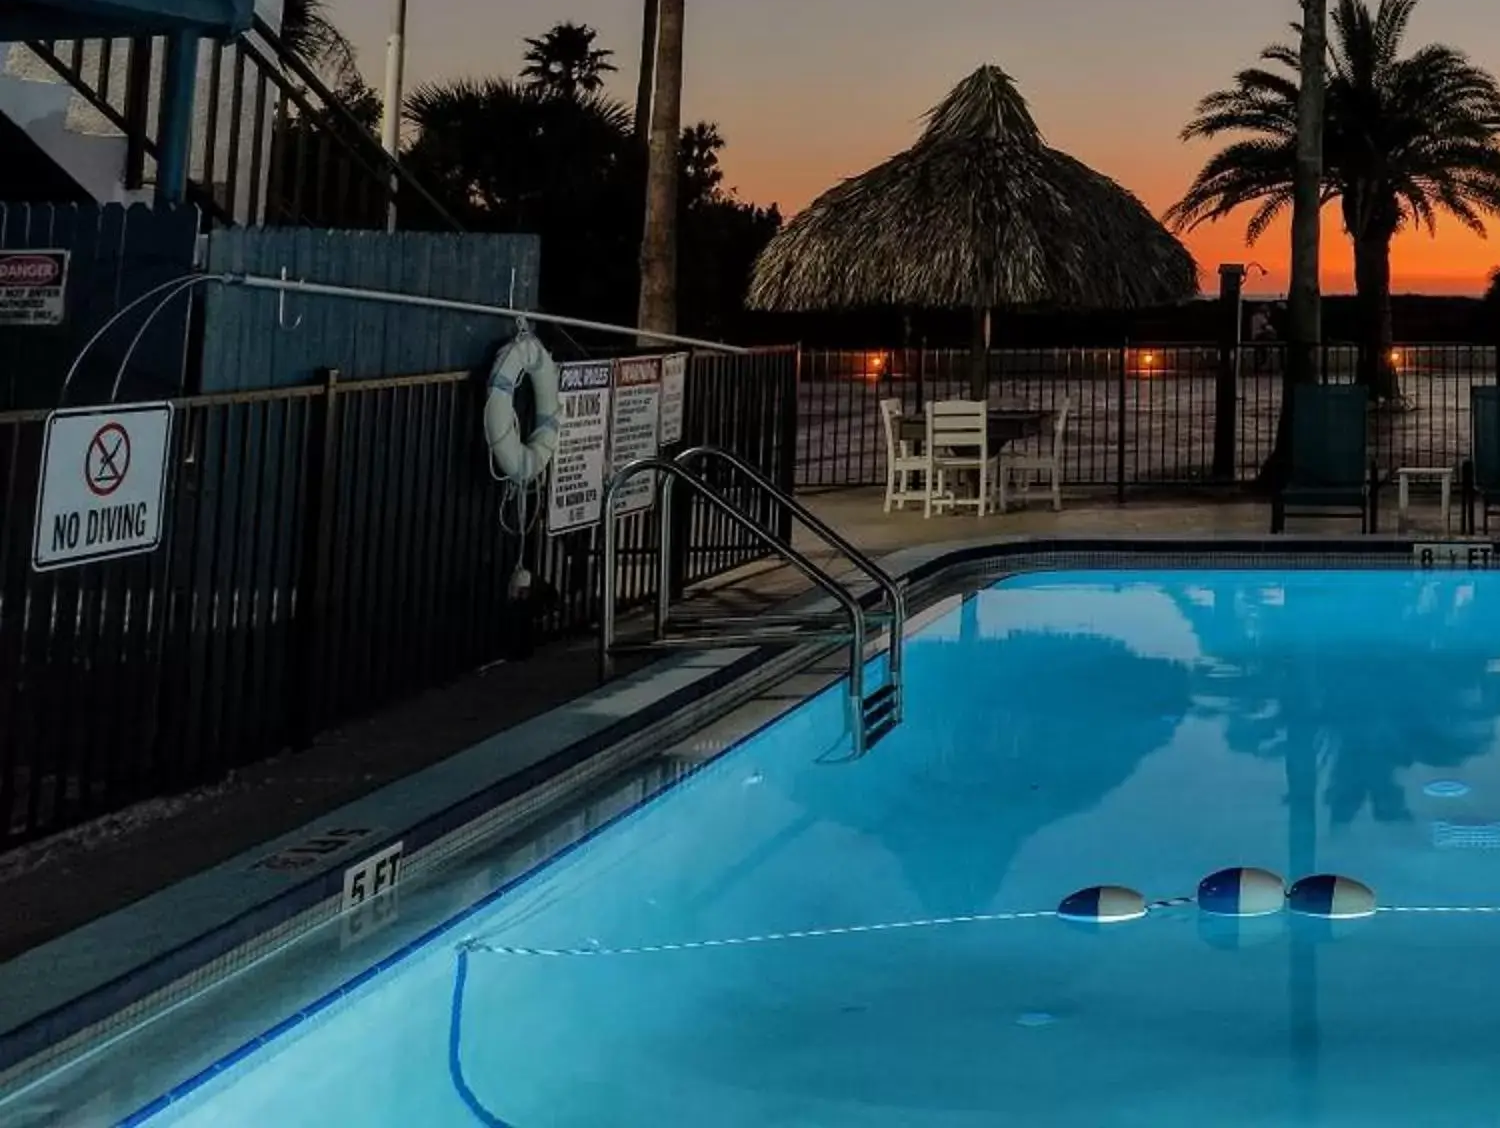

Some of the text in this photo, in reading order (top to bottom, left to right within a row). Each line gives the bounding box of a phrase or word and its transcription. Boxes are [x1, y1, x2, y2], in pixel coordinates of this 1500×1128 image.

[0, 263, 53, 278] DANGER
[561, 366, 609, 389] POOL RULES
[52, 502, 147, 552] NO DIVING
[1468, 548, 1491, 566] FT
[351, 852, 401, 907] 5 FT
